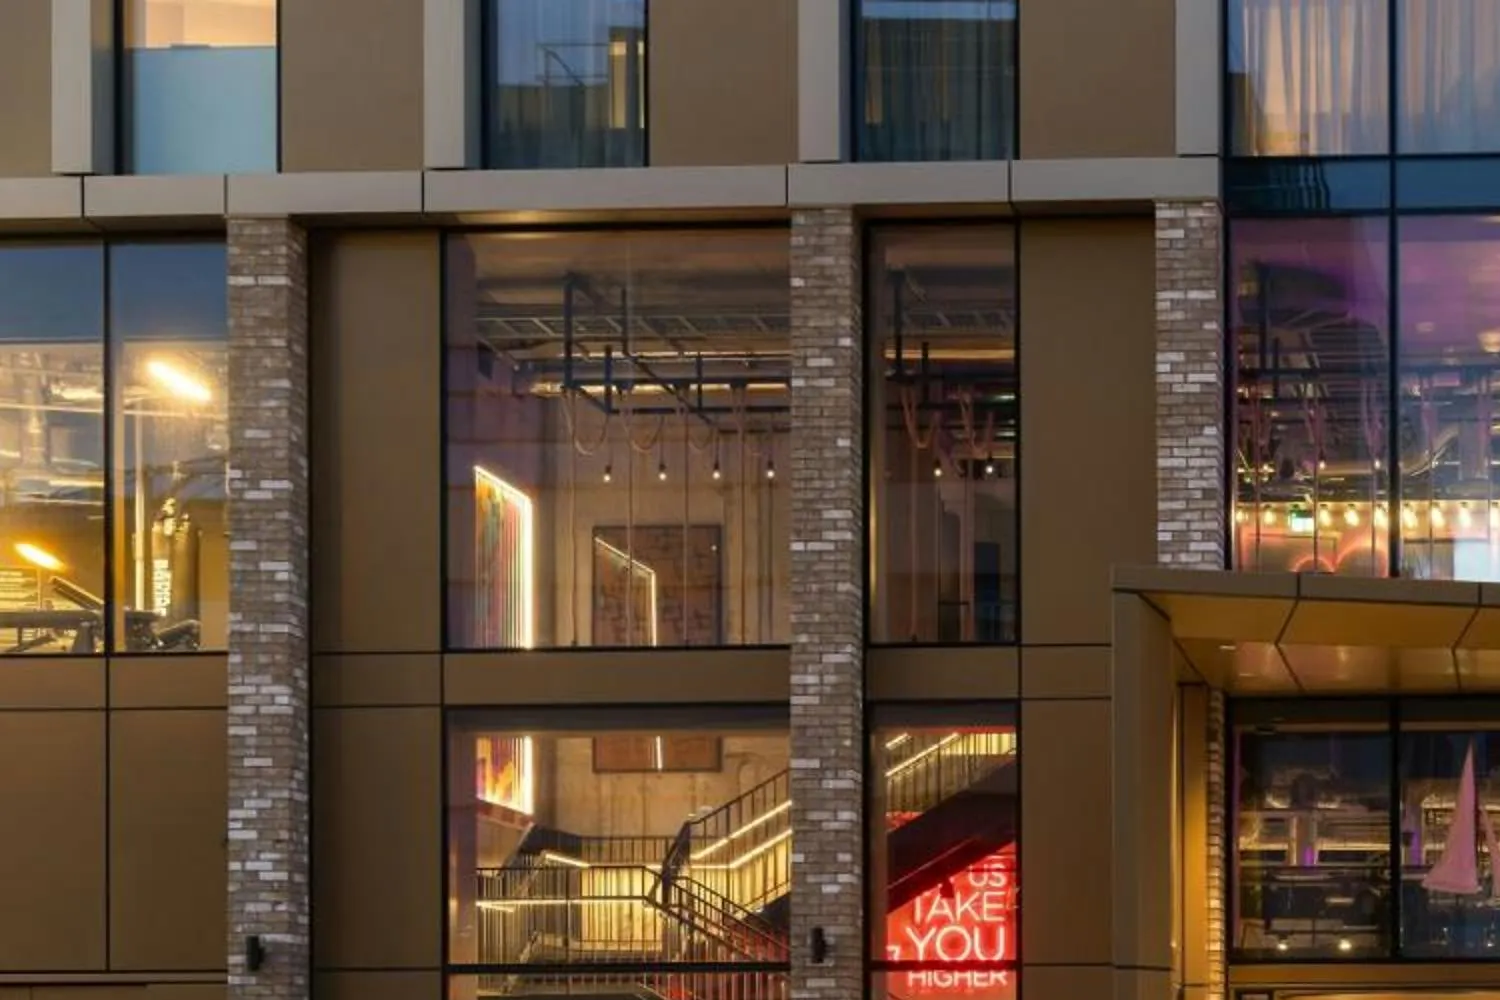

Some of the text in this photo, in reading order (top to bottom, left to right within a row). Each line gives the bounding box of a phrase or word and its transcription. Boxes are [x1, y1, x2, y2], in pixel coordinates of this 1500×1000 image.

[968, 863, 1007, 887] US
[914, 891, 1006, 925] TAKE
[905, 925, 1005, 962] YOU
[907, 969, 1008, 988] HIGHER
